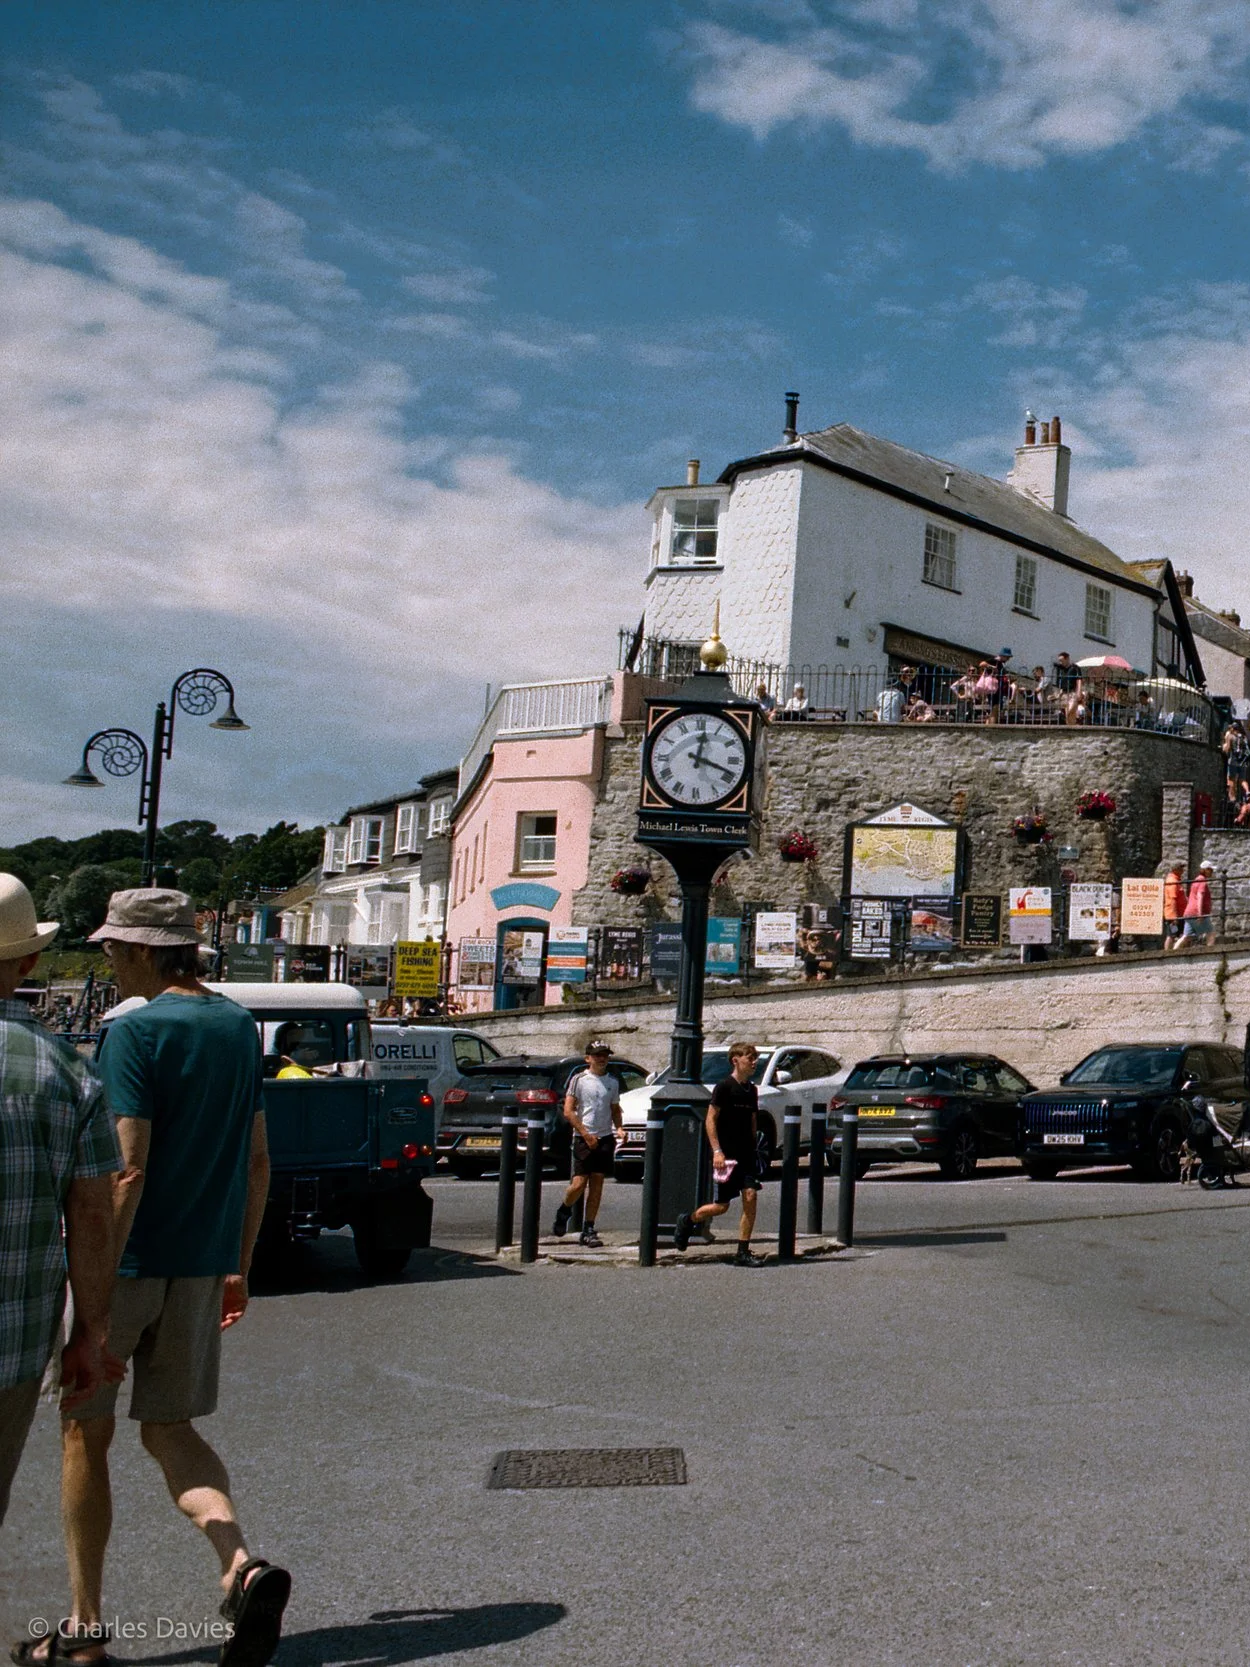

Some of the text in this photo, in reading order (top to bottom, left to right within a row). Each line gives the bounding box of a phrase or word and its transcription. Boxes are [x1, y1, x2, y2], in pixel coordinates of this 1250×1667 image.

[640, 820, 747, 835] Michael Lewis Town Clerk
[1127, 884, 1139, 892] Lal
[852, 920, 863, 942] DELI
[656, 933, 682, 944] Jurassi
[399, 947, 437, 956] DEEP SEA
[402, 957, 433, 966] FISHING
[373, 1044, 436, 1059] ORELLI
